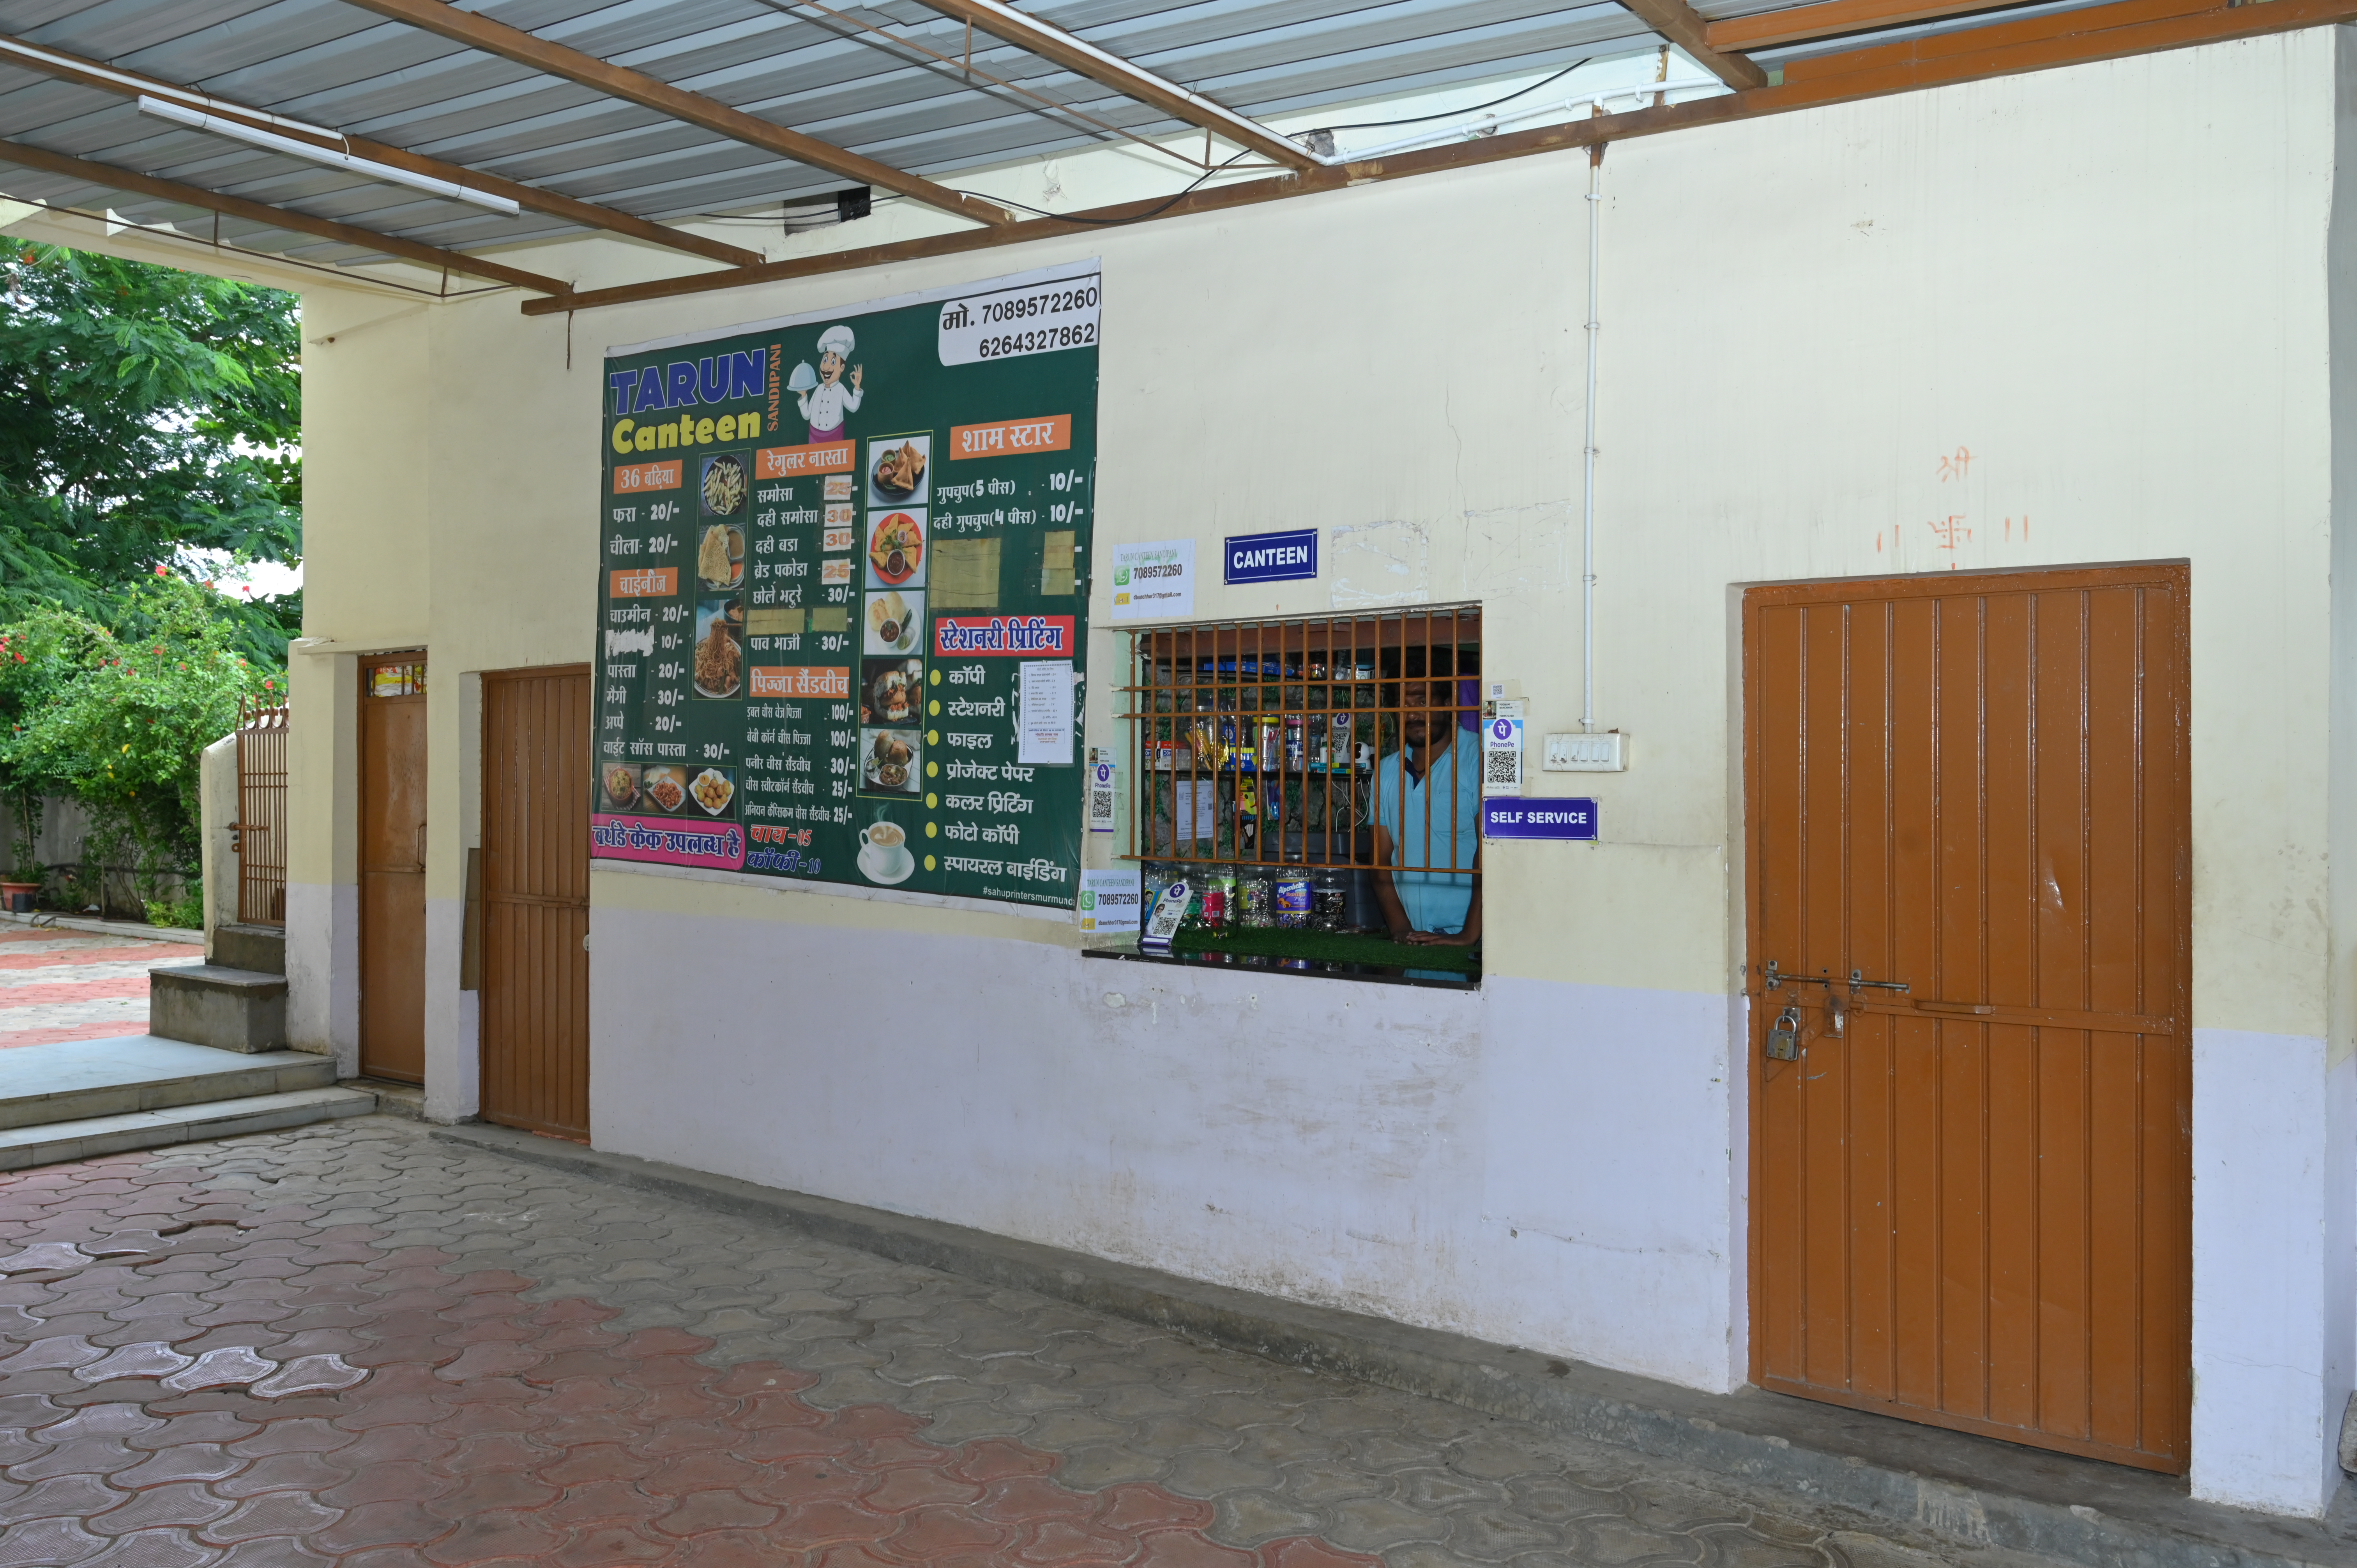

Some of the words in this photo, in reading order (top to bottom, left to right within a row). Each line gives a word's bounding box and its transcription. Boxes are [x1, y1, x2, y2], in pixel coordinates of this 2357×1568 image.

[942, 303, 975, 330] मो.
[982, 287, 1097, 324] 7089572260
[979, 323, 1095, 358] 6264327862
[610, 348, 765, 415] TARUN
[767, 344, 781, 431] SANDIPANI
[612, 411, 760, 454] Canteen
[962, 427, 1005, 452] शाम
[1010, 422, 1055, 447] स्टार
[767, 450, 806, 477] रेगुलर
[809, 448, 848, 466] नास्ता
[621, 468, 640, 488] 36
[1050, 469, 1083, 492] 10/-
[757, 484, 793, 503] समोसा
[613, 507, 636, 523] फरा
[650, 501, 679, 521] 20/-
[757, 508, 776, 527] दही
[781, 505, 818, 524] समोसा
[827, 509, 852, 523] 30
[933, 512, 952, 530] दही
[1050, 501, 1083, 523] 10/-
[649, 533, 678, 554] 20/-
[756, 535, 774, 554] दही
[779, 538, 798, 552] बडा
[825, 532, 851, 546] 30
[1120, 553, 1134, 562] TARUN
[1134, 551, 1154, 560] CANTEEN
[1154, 549, 1177, 559] SANDIPANI
[1233, 546, 1307, 569] CANTEEN
[754, 560, 770, 579] ब्रेड
[774, 558, 808, 577] पकोडा
[1134, 564, 1182, 579] 7089572260
[620, 569, 666, 597] चाईनीज
[753, 585, 776, 604] छोले
[828, 585, 855, 603] 30/-
[610, 604, 651, 623] चाउमीन
[663, 604, 689, 623] 20/-
[661, 633, 683, 650] 10/-
[751, 637, 770, 650] पाव
[774, 633, 800, 650] भाजी
[822, 634, 849, 652] 30/-
[940, 619, 1005, 651] स्टेशनरी
[608, 665, 636, 678] पास्ता
[659, 662, 685, 680] 20/-
[751, 668, 793, 692] पिज्जा
[796, 668, 849, 694] सैंडवीच
[949, 664, 986, 685] कॉपी
[606, 685, 627, 704] मैगी
[657, 689, 684, 706] 30/-
[762, 703, 773, 718] चीस
[775, 703, 784, 718] वेज
[786, 703, 802, 719] पिज्जा
[832, 703, 853, 722] 100/-
[948, 696, 1005, 717] स्टेशनरी
[605, 711, 624, 729] अप्पे
[655, 715, 682, 733] 20/-
[1498, 722, 1507, 736] पे
[603, 737, 625, 757] वाईट
[630, 738, 653, 755] सॉस
[657, 743, 686, 757] पास्ता
[703, 743, 730, 760] 30/-
[747, 727, 759, 743] बेबी
[761, 728, 775, 743] कॉर्न
[778, 729, 791, 744] चीस
[793, 729, 811, 745] पिज्जा
[831, 729, 856, 749] 100/-
[947, 733, 993, 749] फाइल
[746, 754, 763, 769] पनीर
[767, 755, 782, 770] चीस
[785, 755, 811, 772] सैंडवीच
[830, 756, 855, 776] 30/-
[946, 758, 998, 780] प्रोजेक्ट
[1001, 761, 1035, 782] पेपर
[1100, 766, 1106, 779] पे
[746, 776, 758, 791] चीस
[792, 778, 814, 795] सैंडवीच
[832, 779, 852, 799] 25/-
[945, 794, 985, 810] कलर
[745, 801, 765, 817] अनियन
[767, 802, 793, 819] कैप्सिकम
[795, 804, 807, 820] चीस
[834, 805, 852, 825] 25/-
[1491, 812, 1523, 823] SELF
[1527, 812, 1587, 824] SERVICE
[592, 819, 627, 848] बर्थडे
[628, 822, 663, 850] केक
[664, 831, 725, 857] उपलब्ध
[726, 828, 741, 859] है
[945, 821, 979, 841] फोटो
[982, 824, 1020, 845] कॉपी
[944, 856, 1004, 875] स्पायरल
[983, 886, 1075, 906] #sahuprintersmurmunda
[1174, 886, 1181, 896] पे
[1278, 881, 1305, 894] Alpenliebe
[1098, 893, 1138, 905] 7089572260
